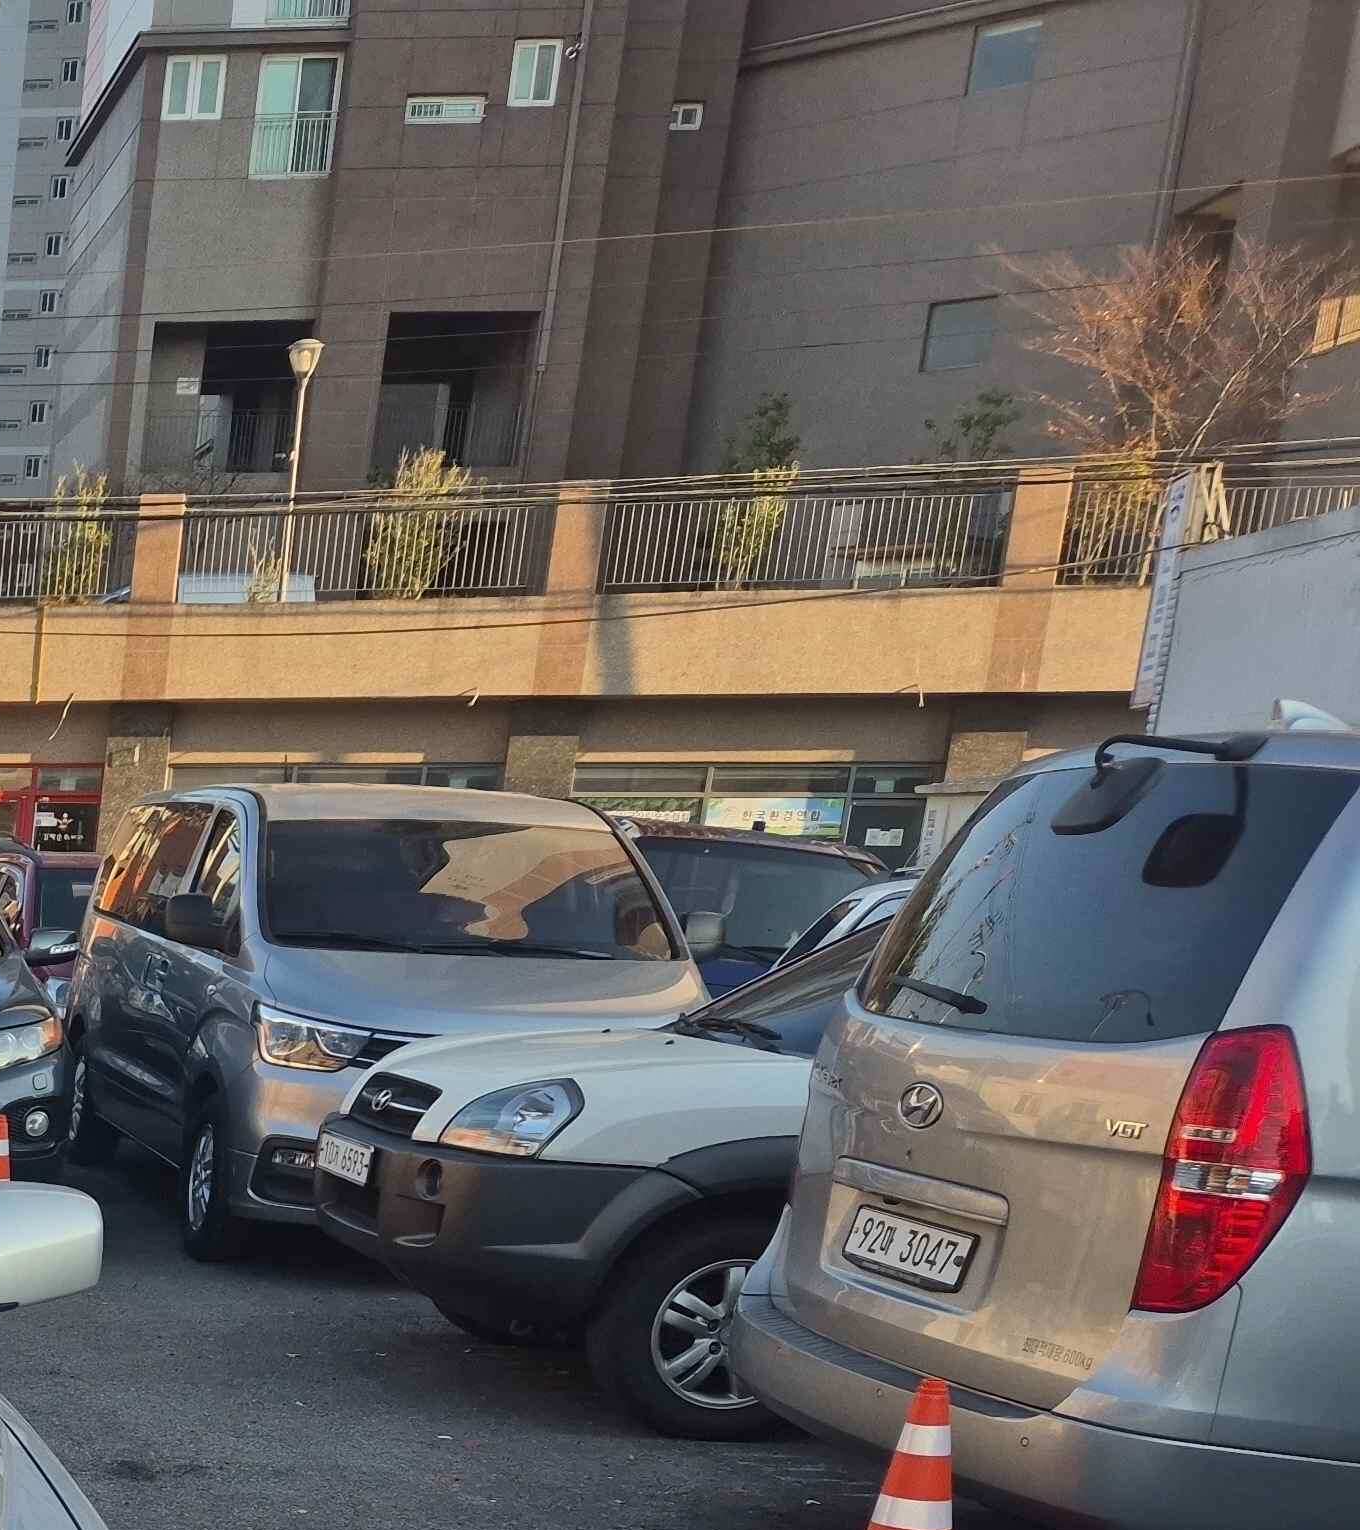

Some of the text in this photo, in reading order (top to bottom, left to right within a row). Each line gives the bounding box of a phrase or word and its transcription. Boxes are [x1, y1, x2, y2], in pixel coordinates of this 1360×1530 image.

[1105, 1119, 1149, 1139] VGT
[857, 1216, 960, 1275] 92마 3047
